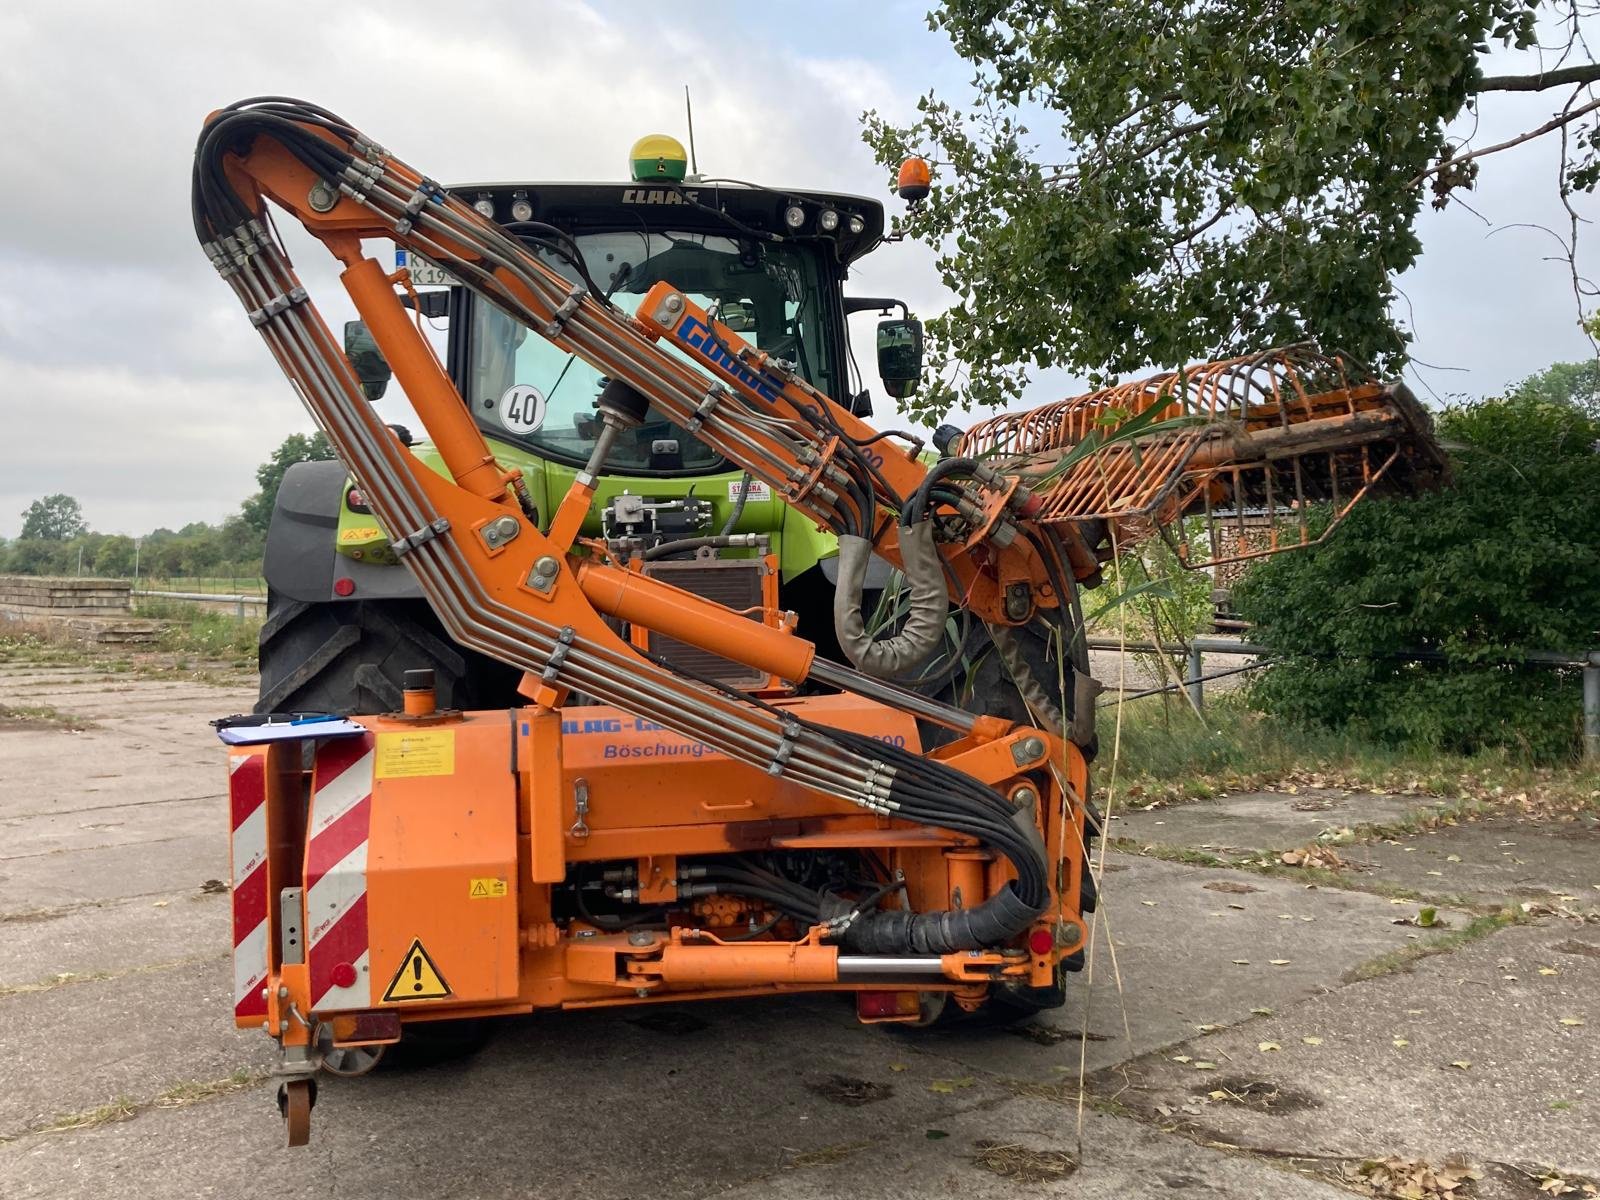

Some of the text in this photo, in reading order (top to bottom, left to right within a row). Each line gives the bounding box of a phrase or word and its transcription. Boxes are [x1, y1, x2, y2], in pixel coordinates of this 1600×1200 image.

[622, 189, 699, 205] CLAAS
[508, 392, 537, 426] 40
[603, 742, 721, 759] Böschungs
